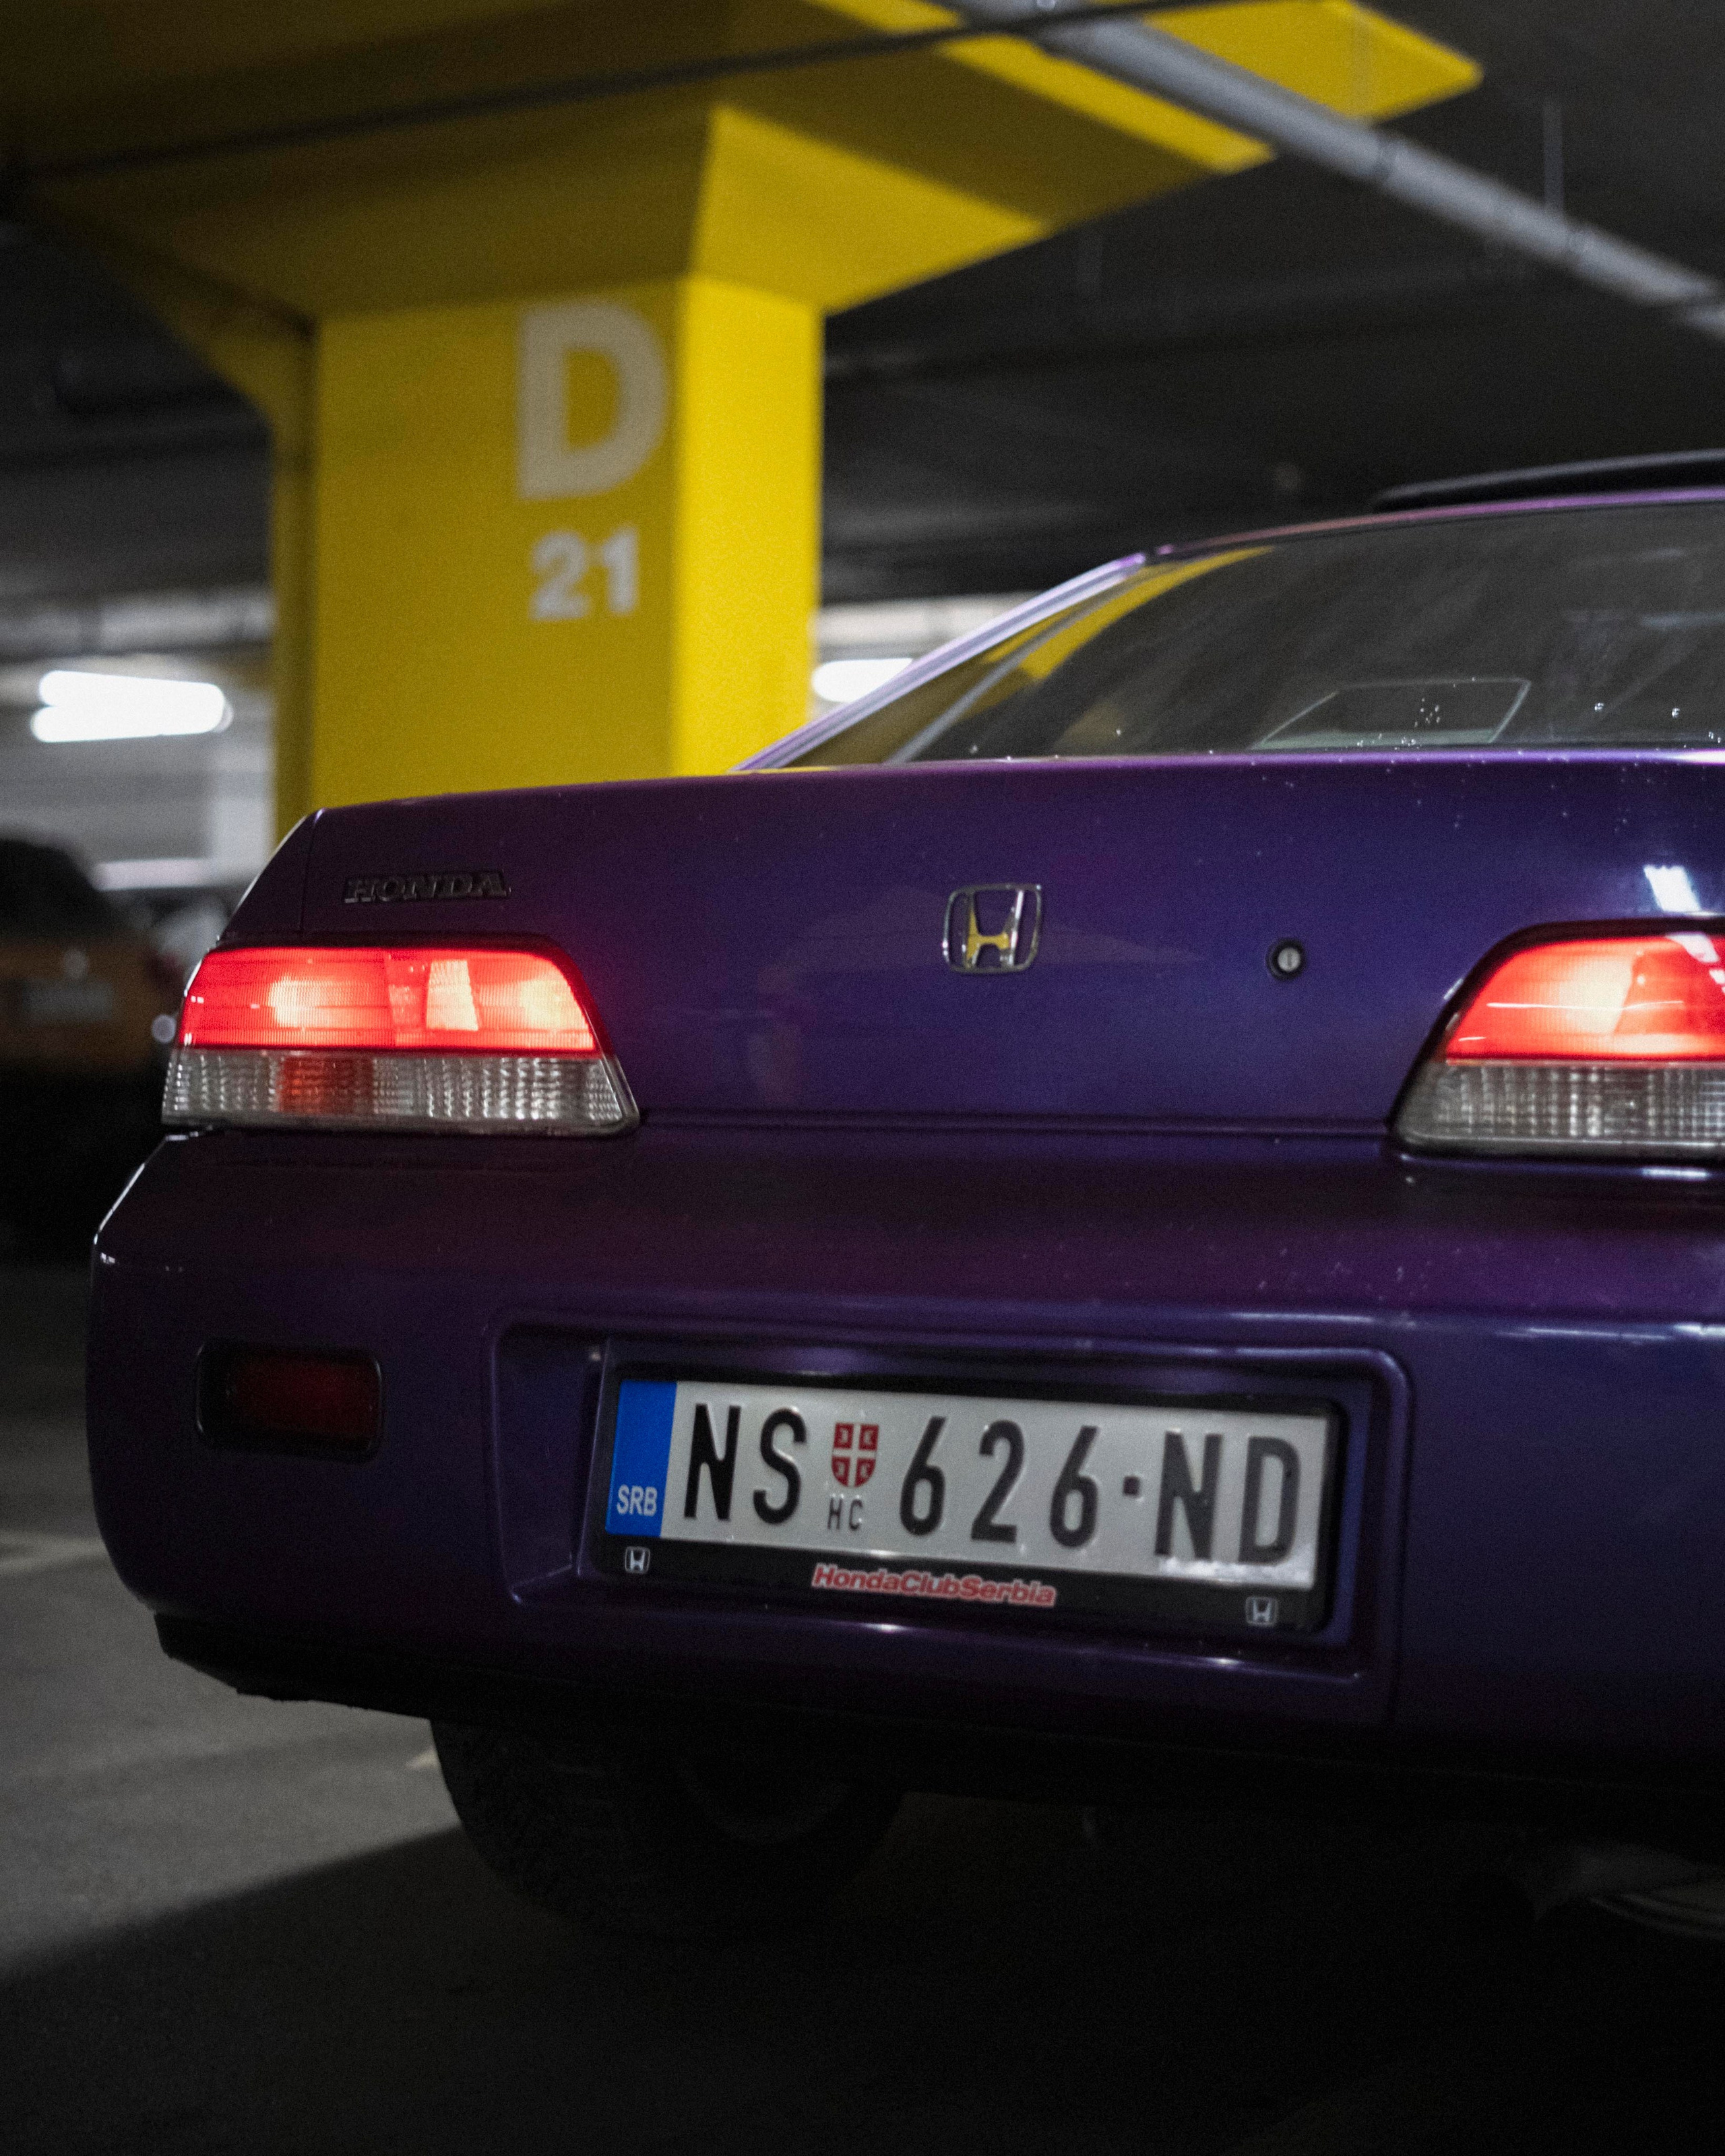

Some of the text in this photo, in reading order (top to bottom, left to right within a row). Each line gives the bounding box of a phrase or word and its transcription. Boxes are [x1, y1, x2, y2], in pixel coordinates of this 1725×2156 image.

[518, 301, 668, 503] D
[530, 527, 637, 622] 21
[344, 871, 509, 903] HONDA
[684, 1403, 808, 1525] NS
[617, 1484, 658, 1517] SRB
[811, 1562, 1057, 1608] HondaClubSerbia
